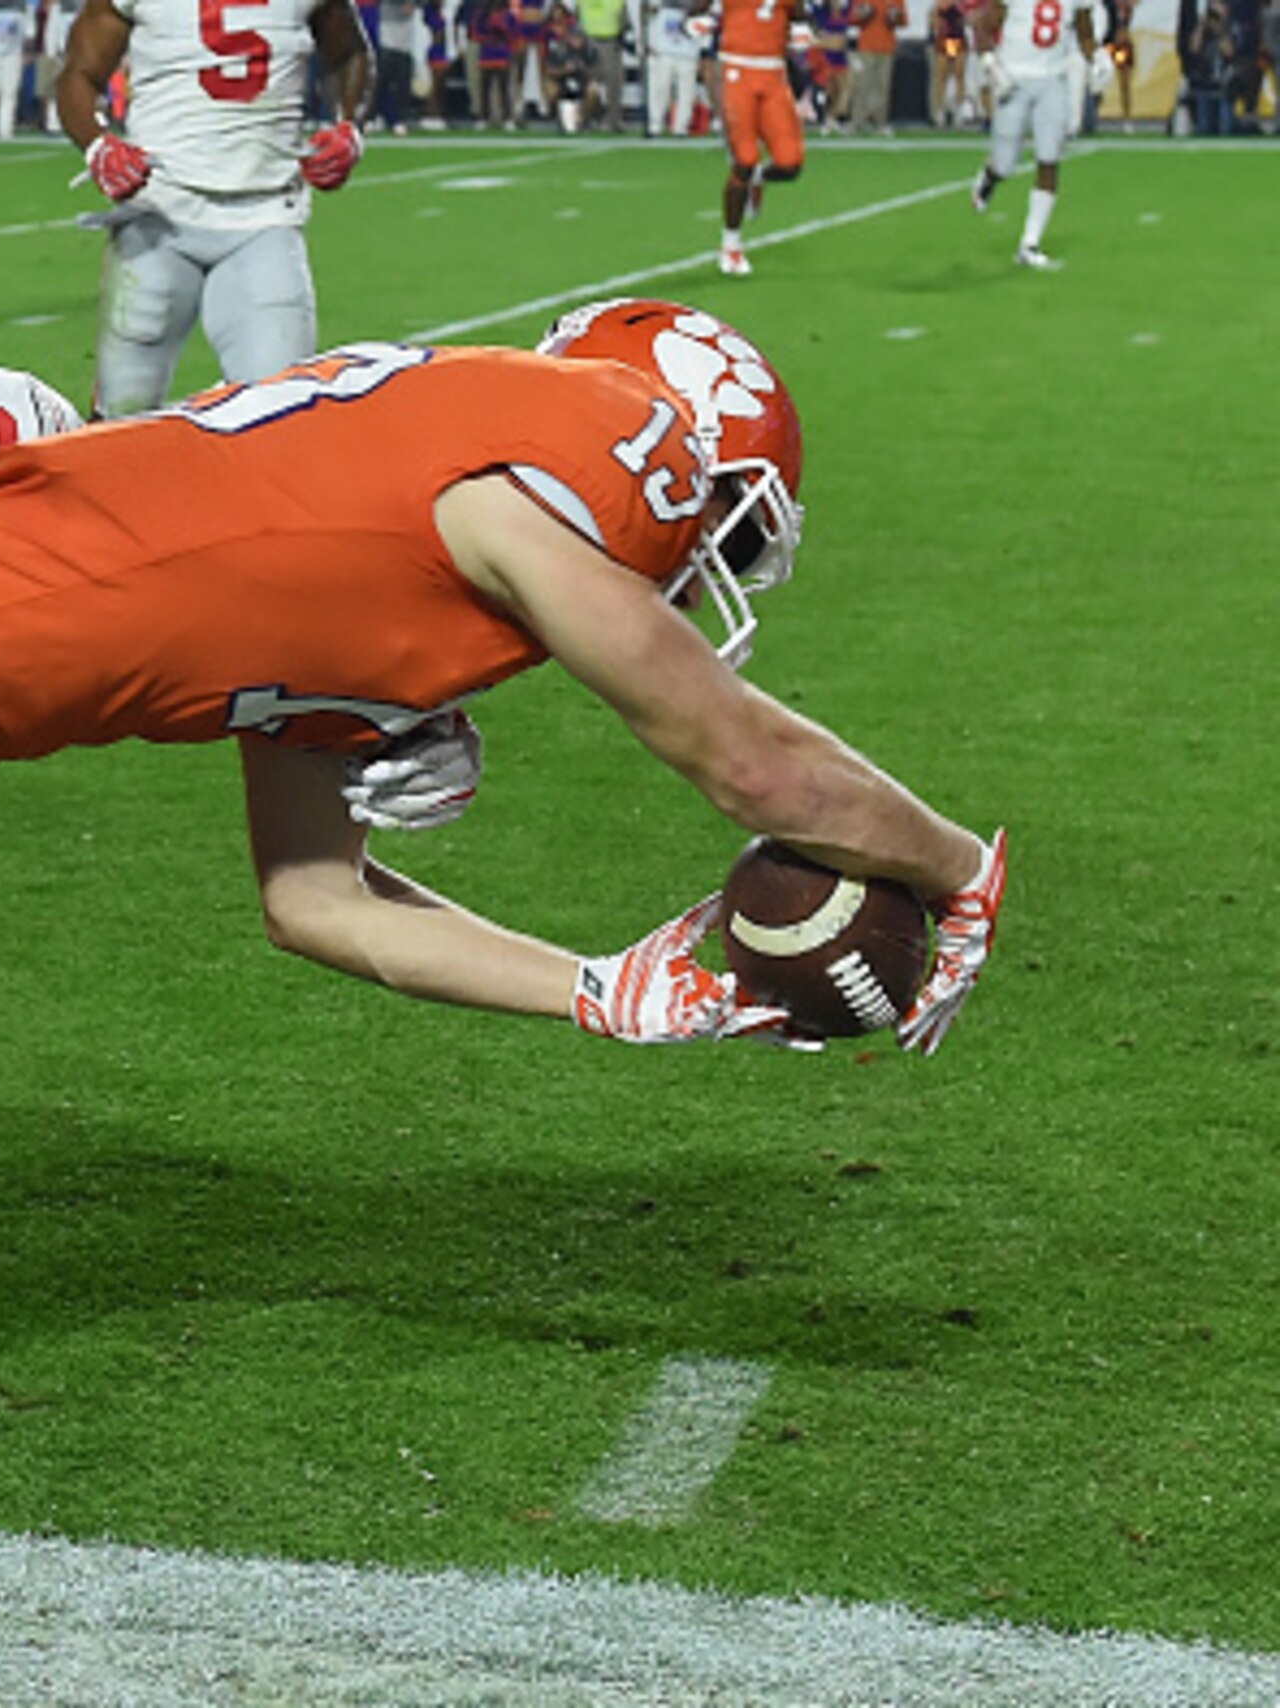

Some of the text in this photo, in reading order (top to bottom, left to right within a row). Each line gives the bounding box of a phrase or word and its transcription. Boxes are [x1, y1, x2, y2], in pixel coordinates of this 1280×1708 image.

[198, 0, 272, 104] 5
[1032, 0, 1062, 49] 8
[609, 397, 706, 523] 13
